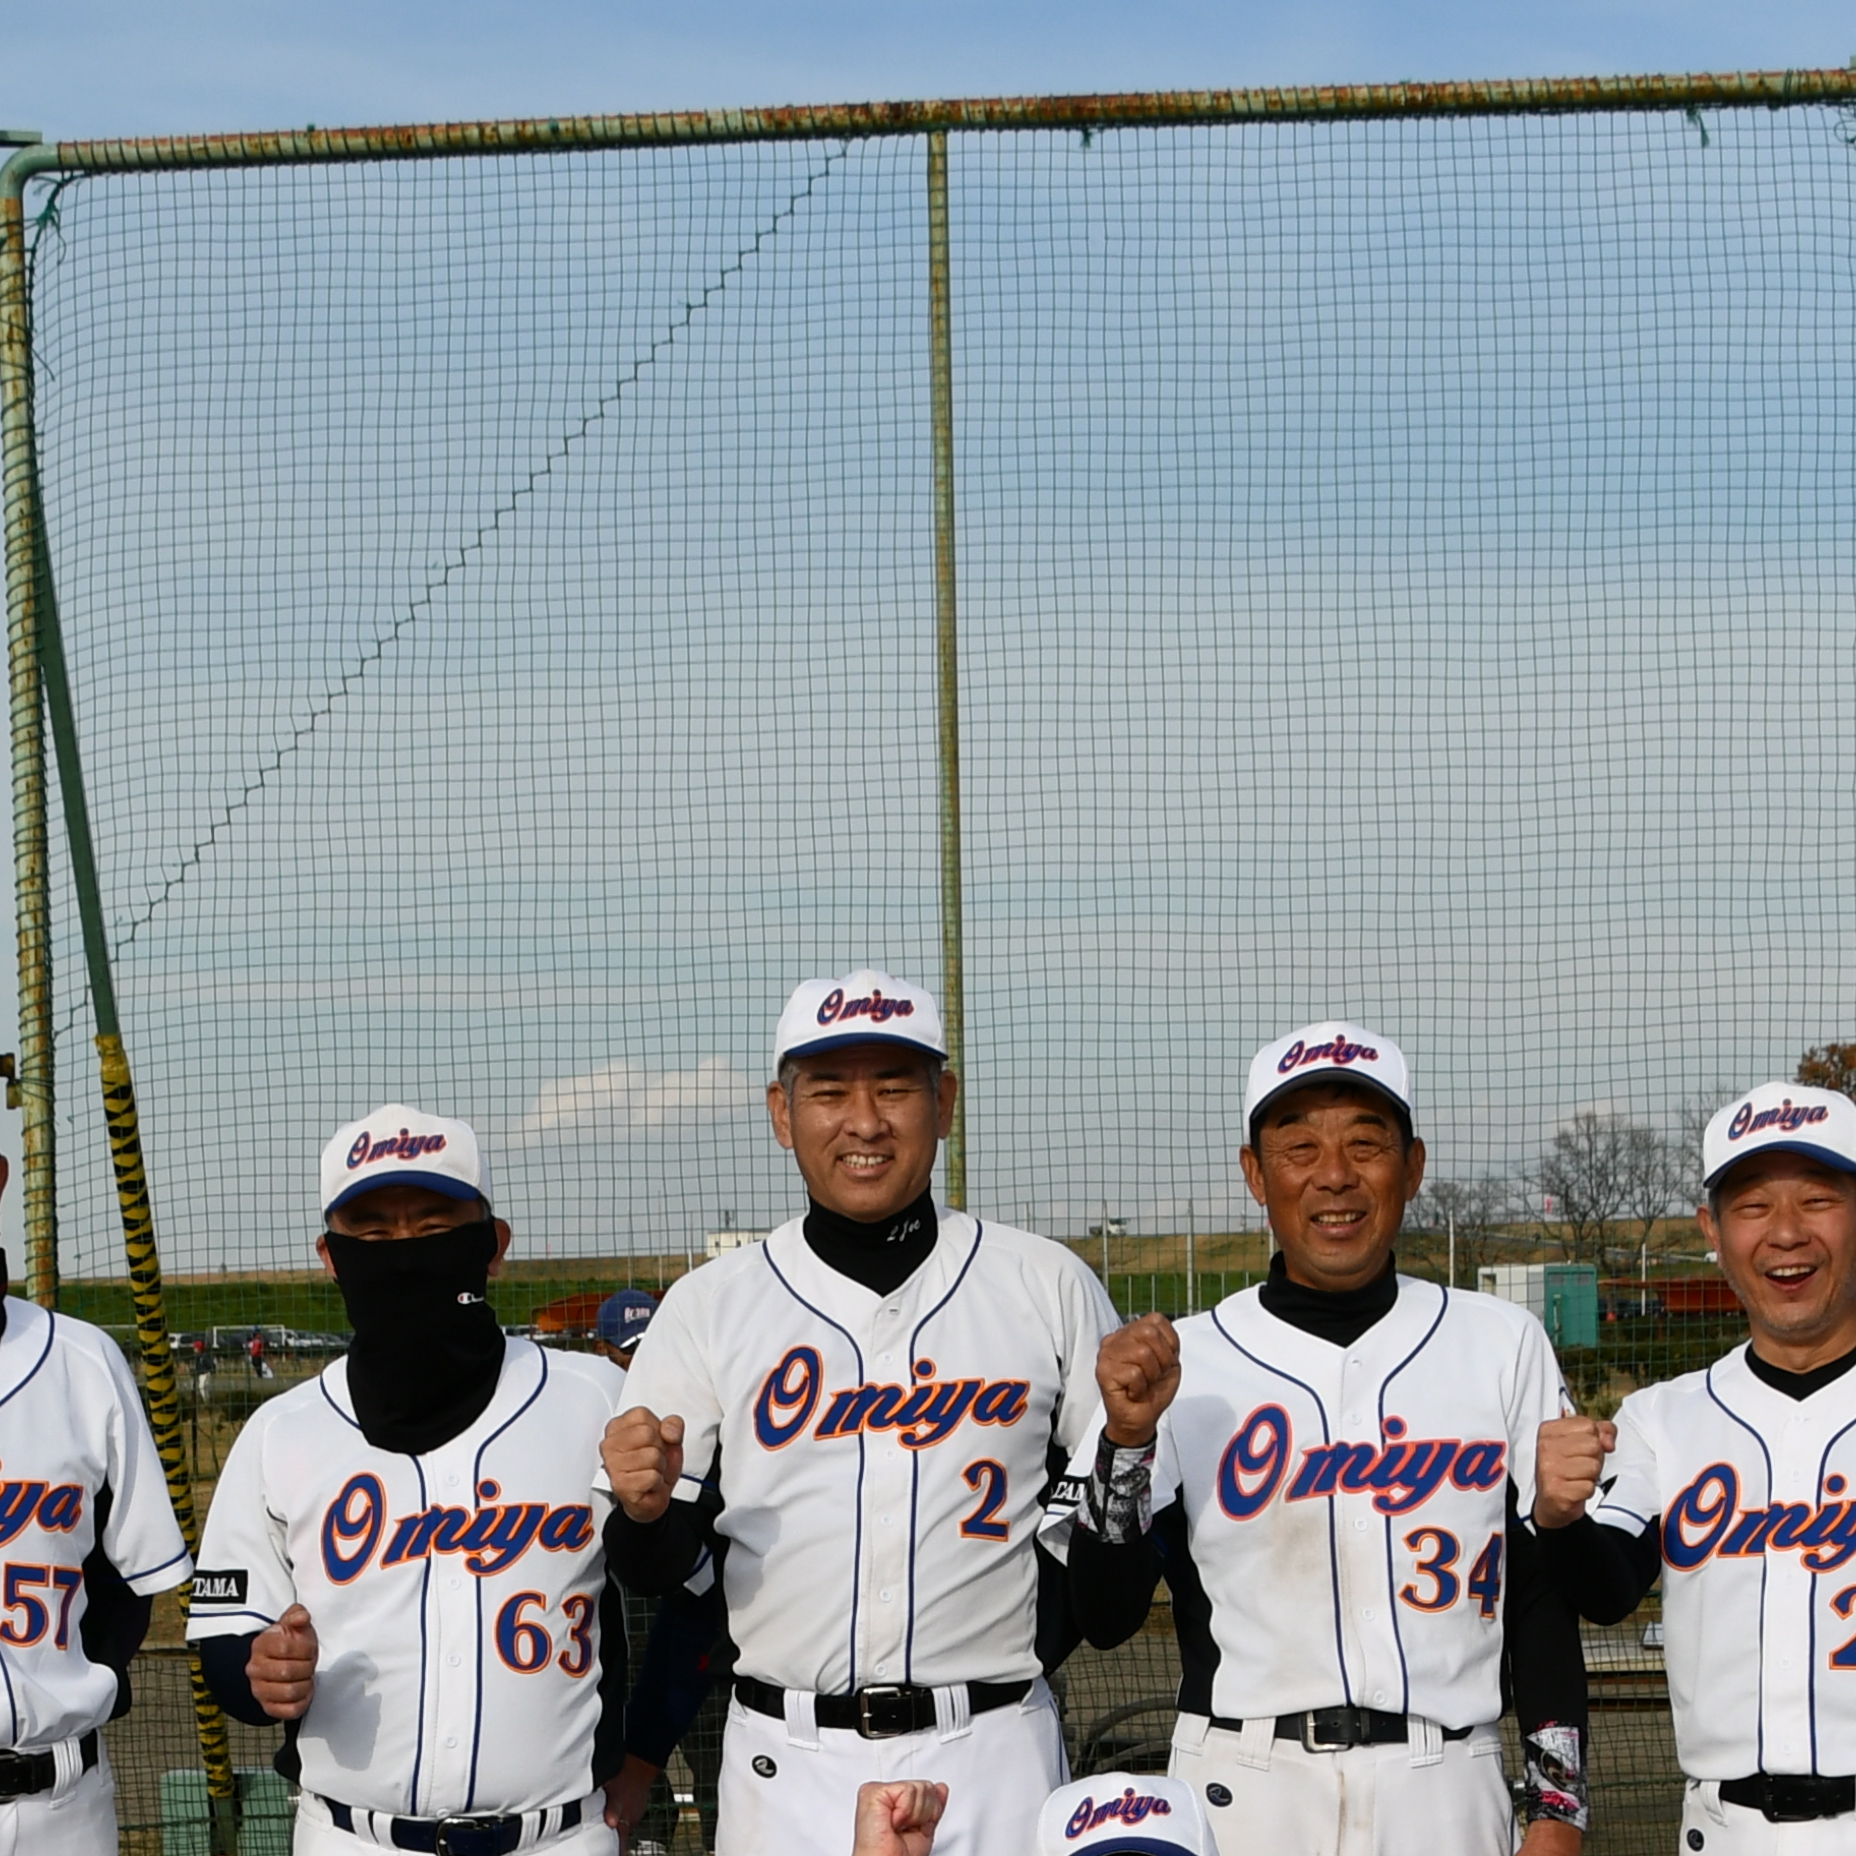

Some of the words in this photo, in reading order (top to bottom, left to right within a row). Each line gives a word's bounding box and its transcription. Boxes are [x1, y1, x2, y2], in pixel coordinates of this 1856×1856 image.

[816, 988, 915, 1027] Omiya
[1277, 1034, 1379, 1074] Omiya
[346, 1128, 446, 1170] Omiya
[1727, 1098, 1829, 1142] Omiya
[753, 1345, 1030, 1451] Omiya
[959, 1458, 1010, 1542] 2
[1216, 1403, 1507, 1520] Omiya
[321, 1472, 594, 1585] Omiya
[1399, 1526, 1503, 1620] 34
[493, 1590, 594, 1678] 63
[1065, 1787, 1173, 1841] Omiya
